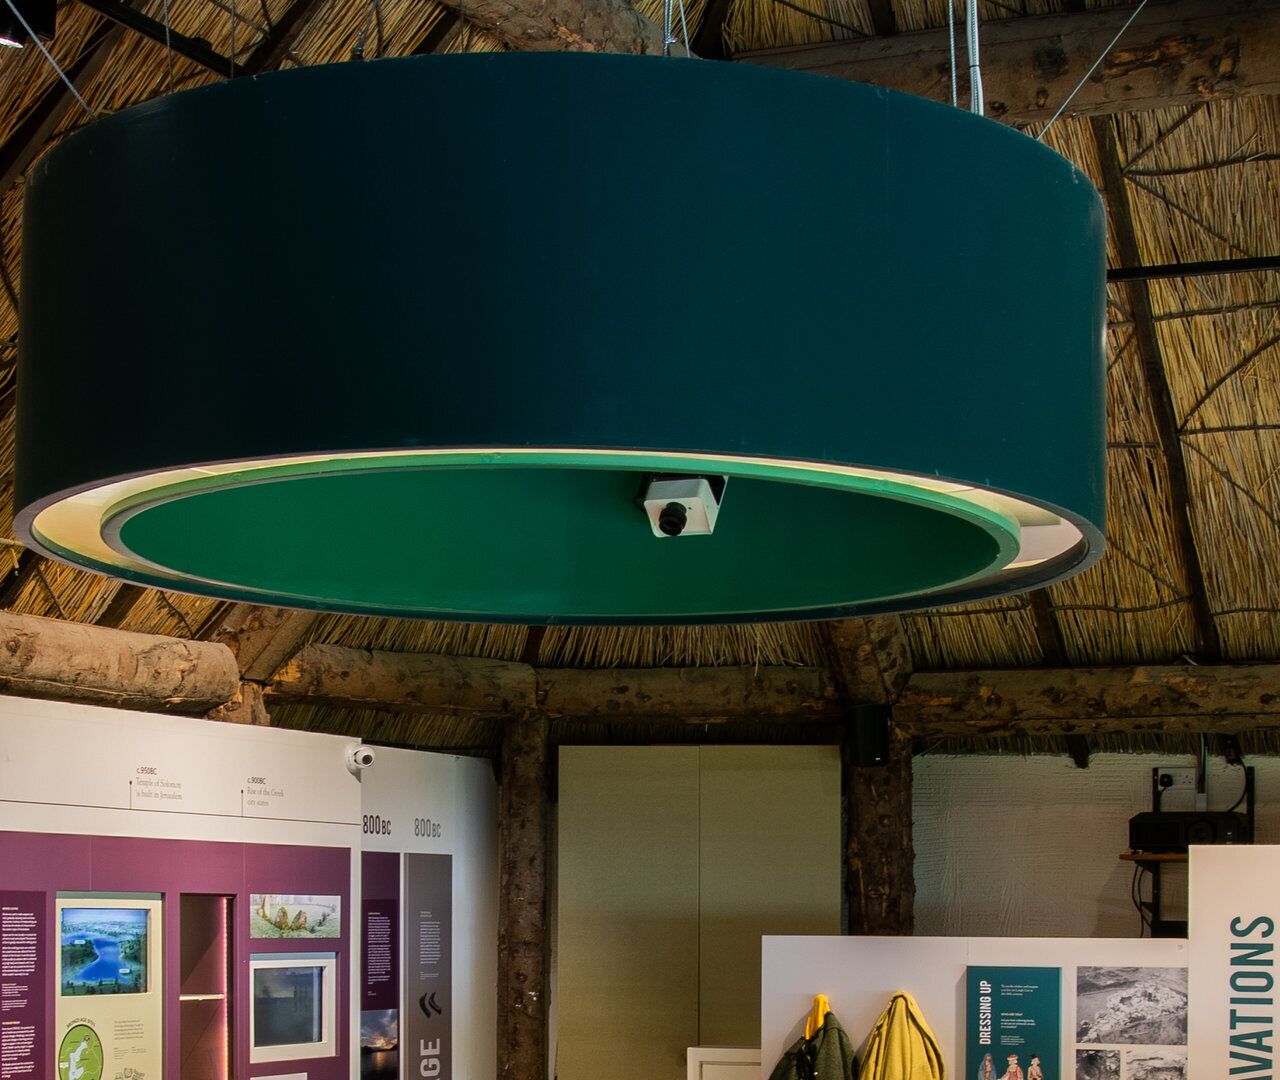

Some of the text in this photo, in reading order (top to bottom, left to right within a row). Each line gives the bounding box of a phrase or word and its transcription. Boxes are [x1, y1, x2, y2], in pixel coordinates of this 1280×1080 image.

[136, 777, 181, 789] Temple of Solomon
[363, 815, 391, 835] 800 BC
[414, 818, 441, 838] 800 BC
[979, 980, 992, 1045] DRESSING UP
